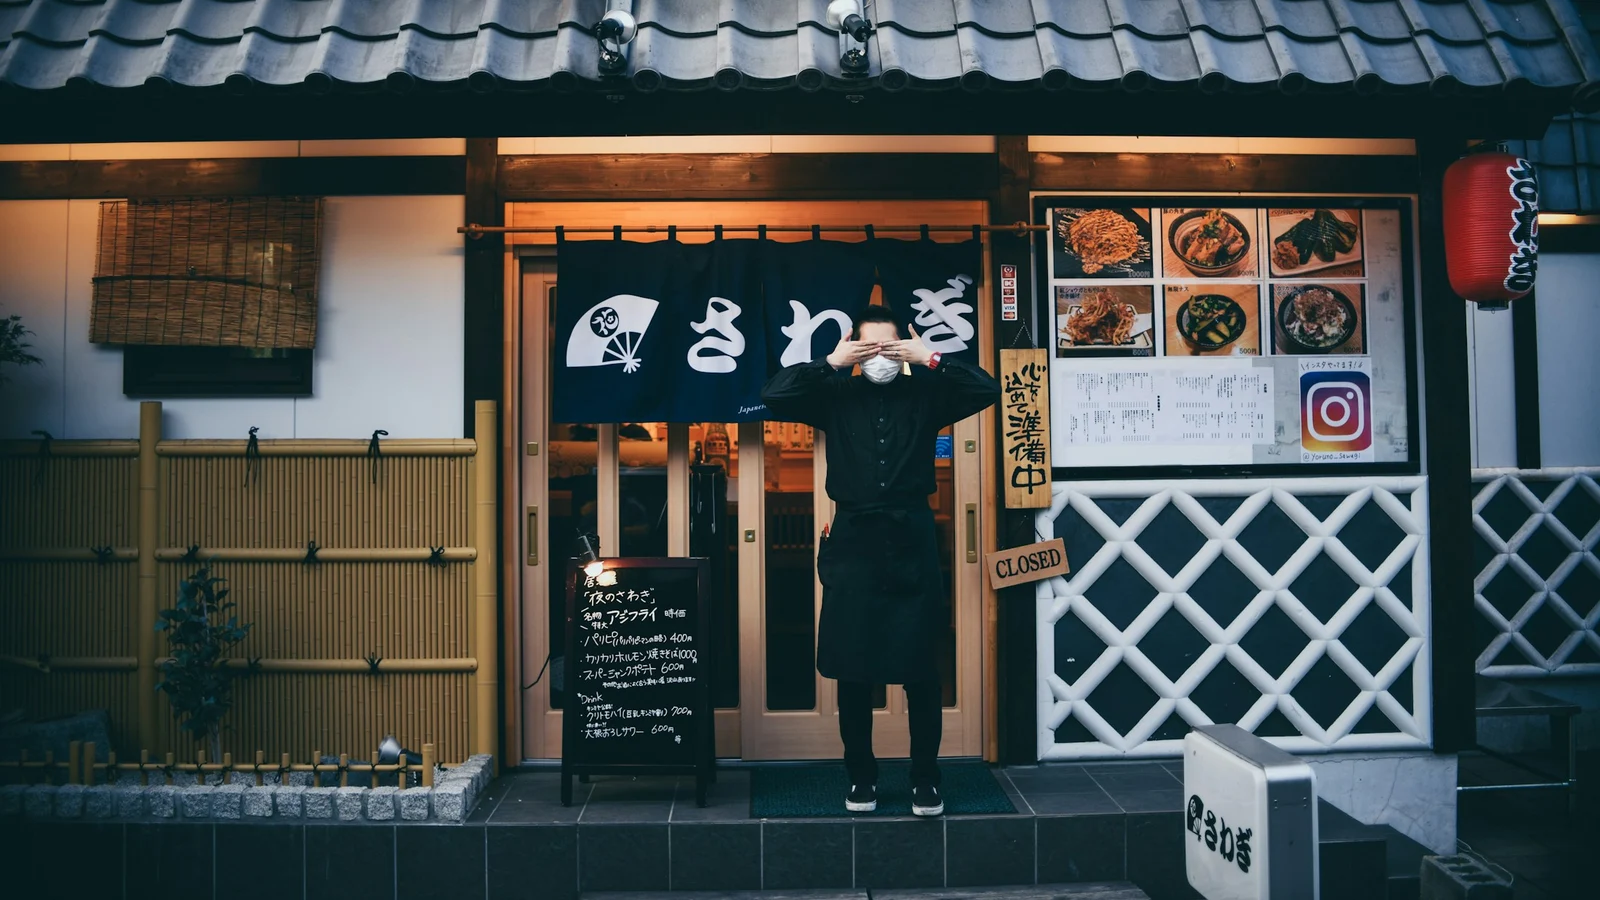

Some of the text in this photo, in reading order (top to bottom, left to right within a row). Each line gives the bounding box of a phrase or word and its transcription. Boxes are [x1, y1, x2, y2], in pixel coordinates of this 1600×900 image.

[996, 548, 1061, 579] CLOSED
[606, 607, 657, 625] アジフライ
[664, 609, 687, 619] 時価
[581, 692, 603, 704] Drink
